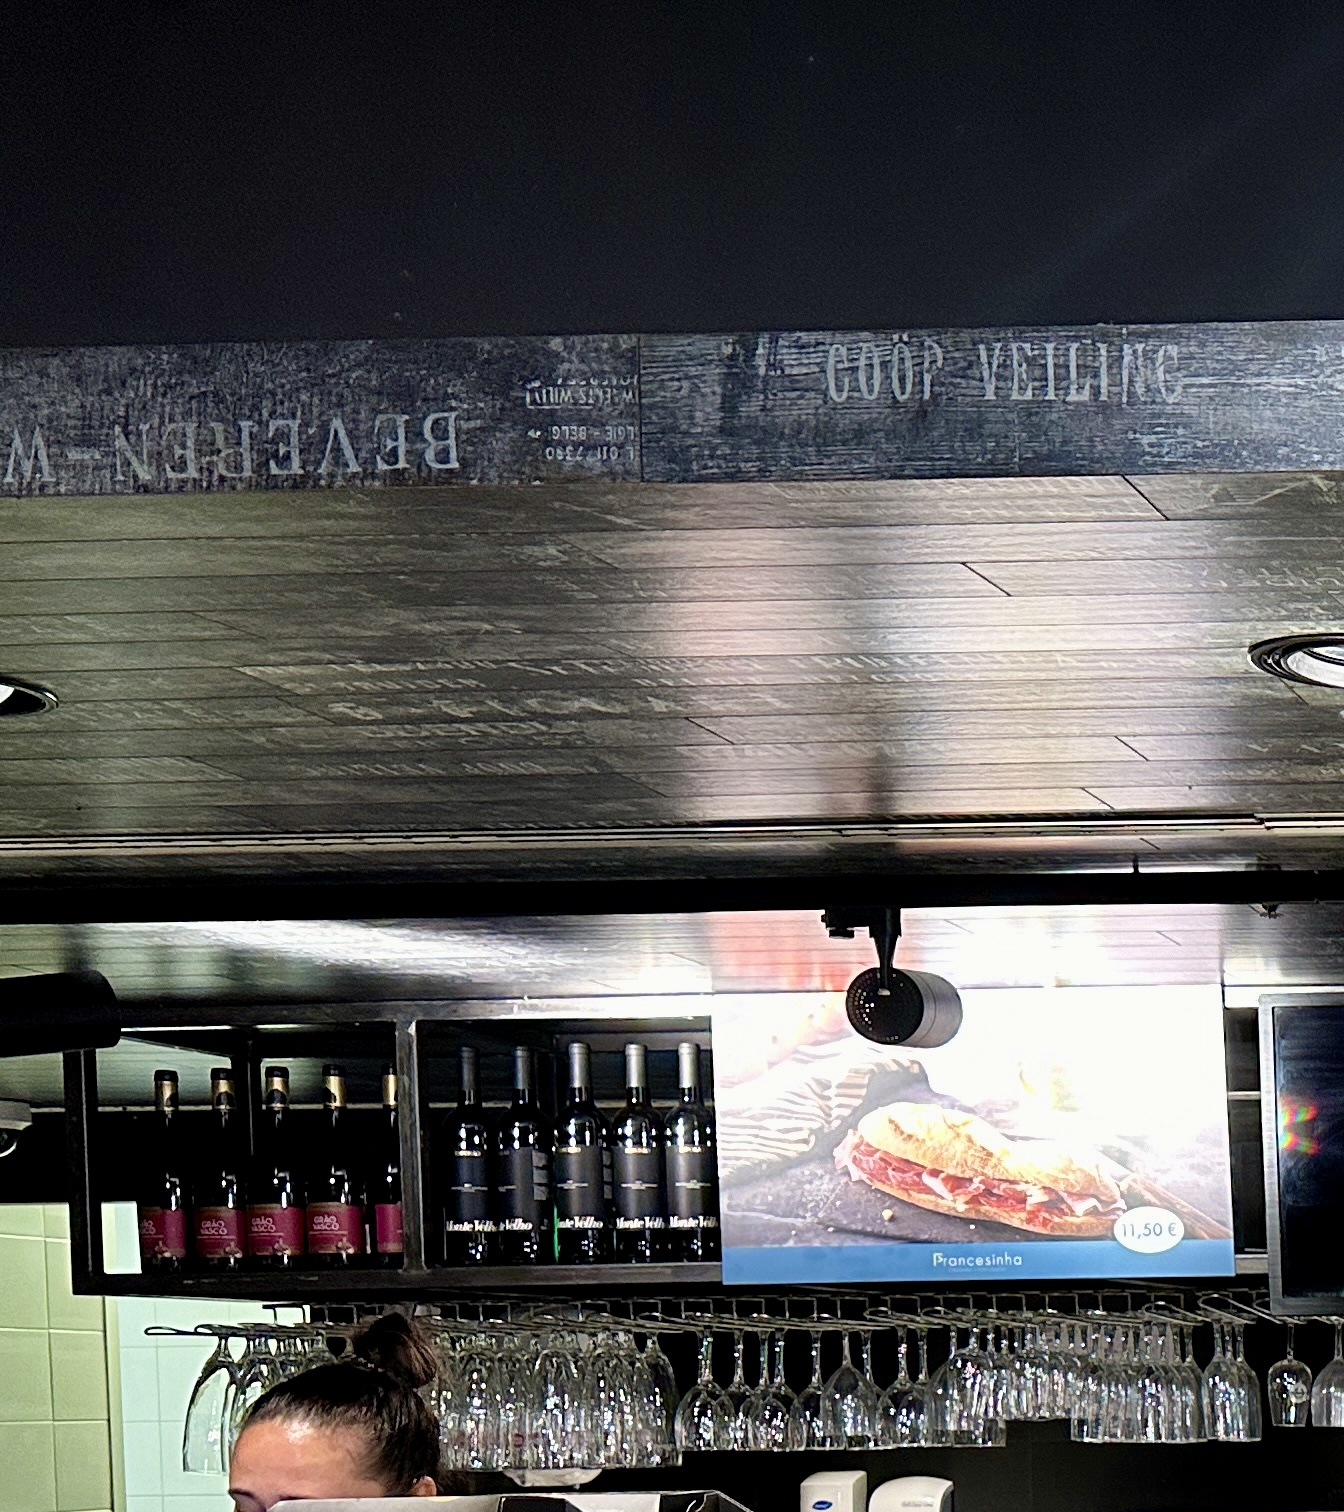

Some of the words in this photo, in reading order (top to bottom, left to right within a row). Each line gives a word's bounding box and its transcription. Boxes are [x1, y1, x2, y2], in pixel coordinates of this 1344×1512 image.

[979, 340, 1185, 405] VEILING
[1120, 1221, 1163, 1241] 11,50
[1166, 1222, 1179, 1239] €
[932, 1251, 1023, 1270] Francesinha
